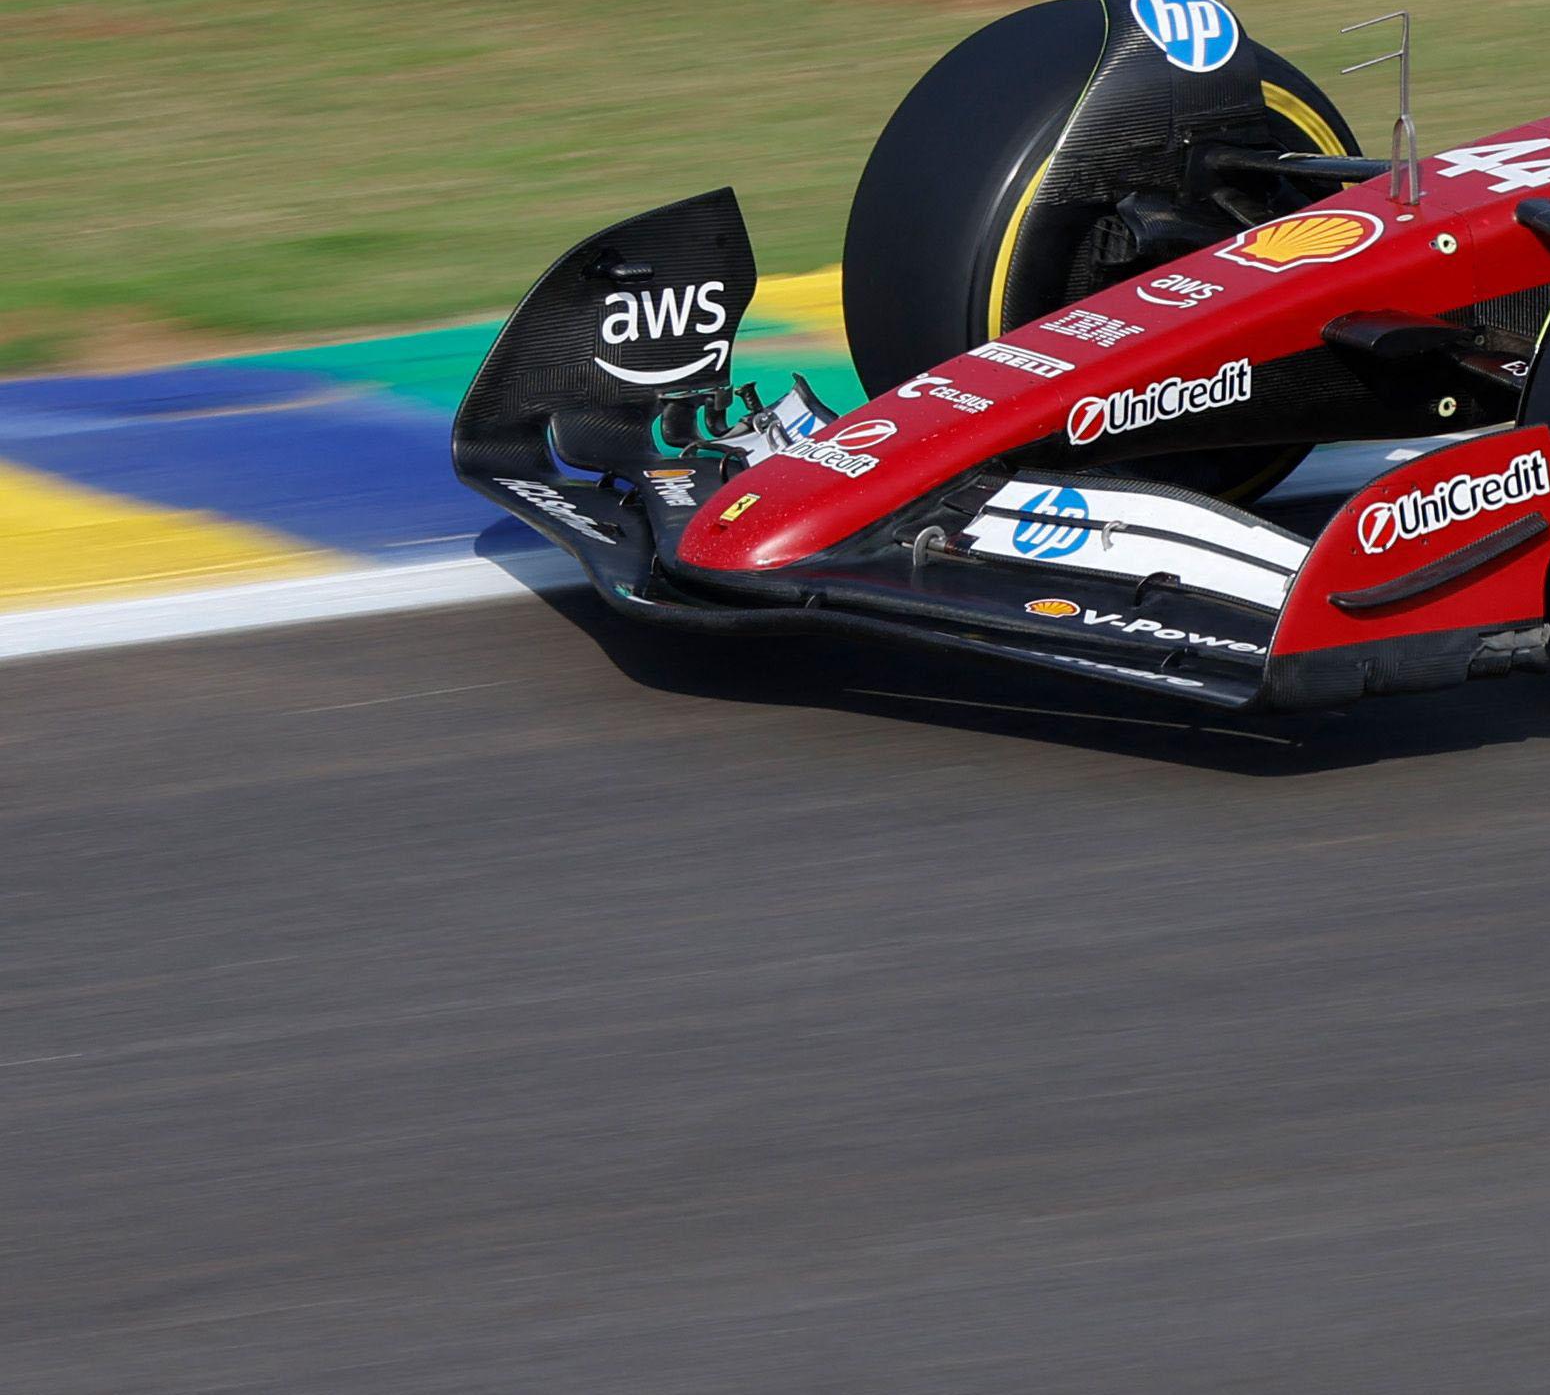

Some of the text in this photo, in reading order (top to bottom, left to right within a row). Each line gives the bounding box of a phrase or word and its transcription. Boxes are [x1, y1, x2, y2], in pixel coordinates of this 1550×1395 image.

[1150, 273, 1225, 301] aws
[601, 280, 728, 346] aws
[1039, 309, 1145, 348] IBM
[966, 341, 1076, 379] PIRELLI
[929, 386, 995, 412] CELSIUS
[1109, 361, 1250, 432] UniCredit
[1400, 456, 1547, 533] UniCredit
